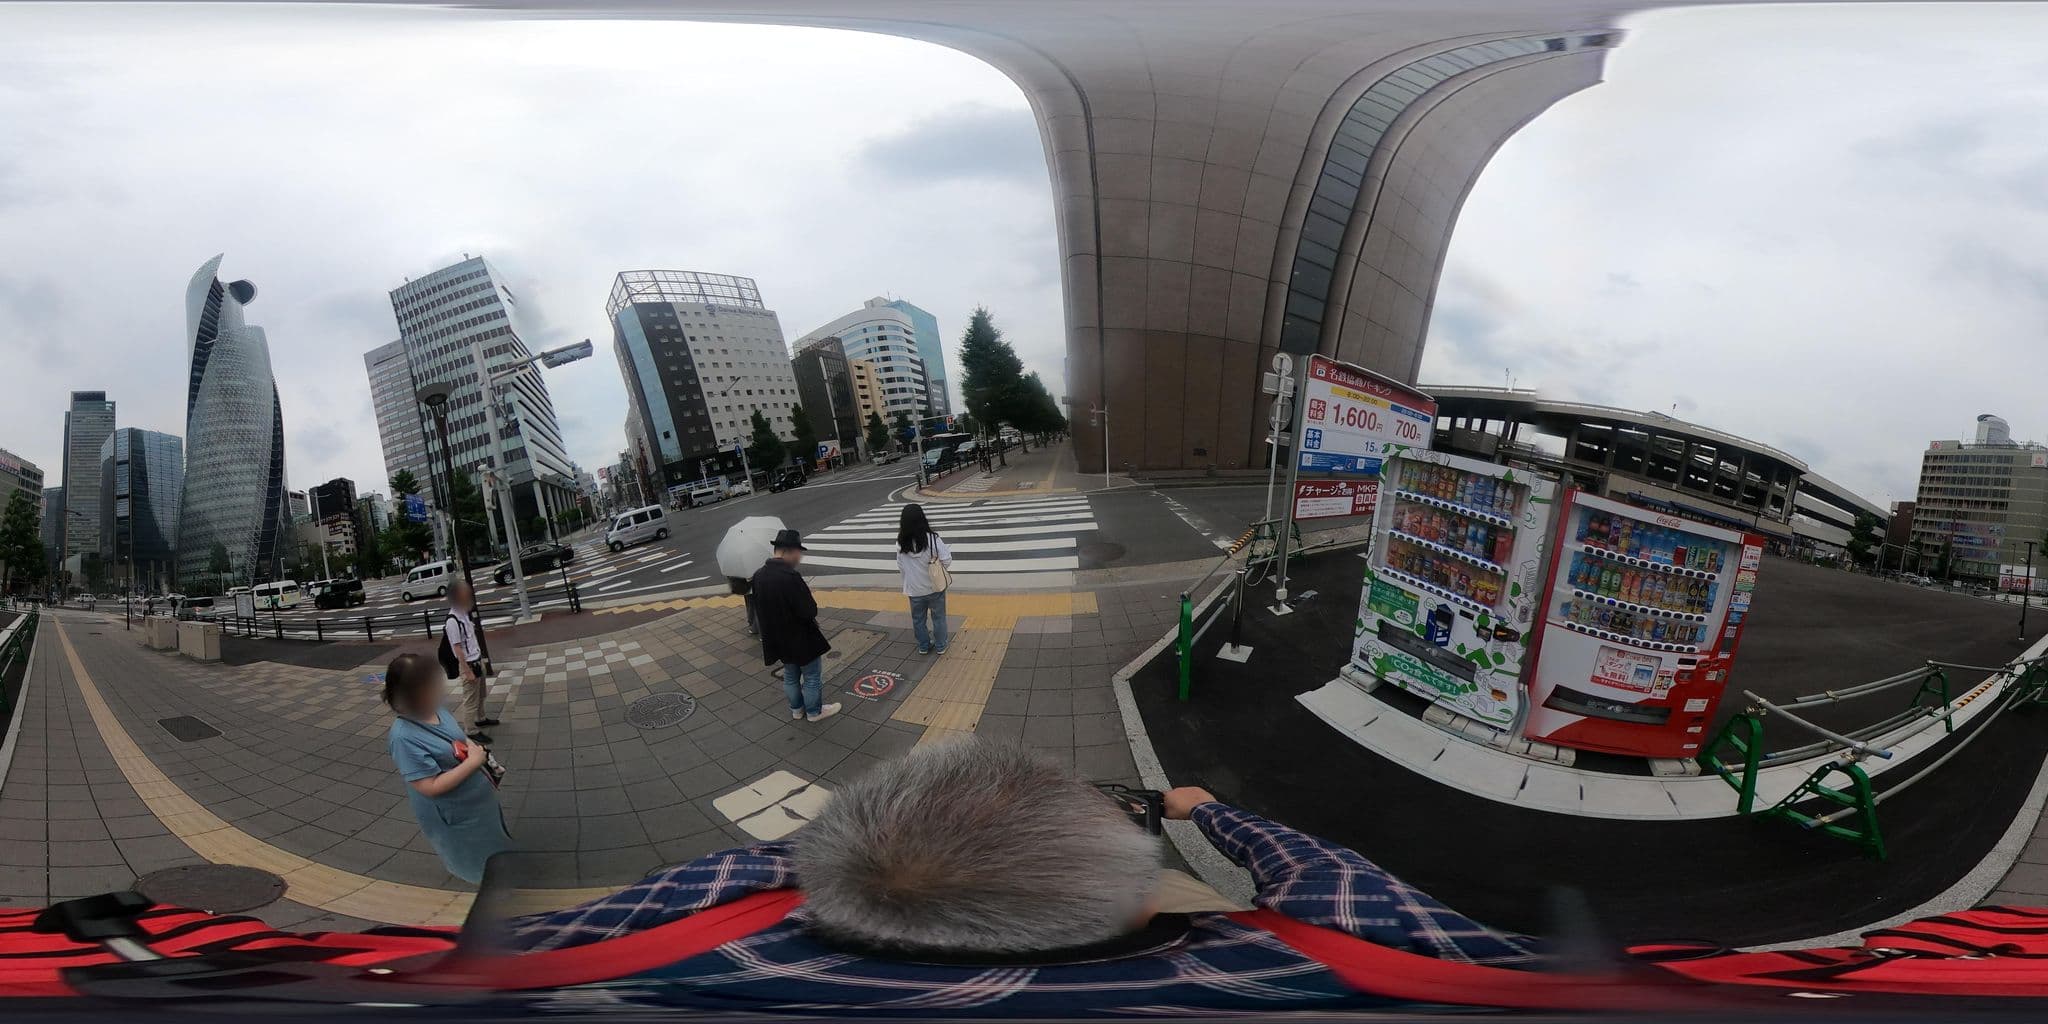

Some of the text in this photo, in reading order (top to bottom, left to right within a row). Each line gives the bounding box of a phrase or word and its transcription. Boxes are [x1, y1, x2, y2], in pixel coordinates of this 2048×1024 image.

[1329, 368, 1392, 396] 名鉄協商パーキング
[1333, 403, 1383, 432] 1,600円
[1395, 419, 1421, 441] 700円
[1656, 515, 1681, 528] Coca-Cola
